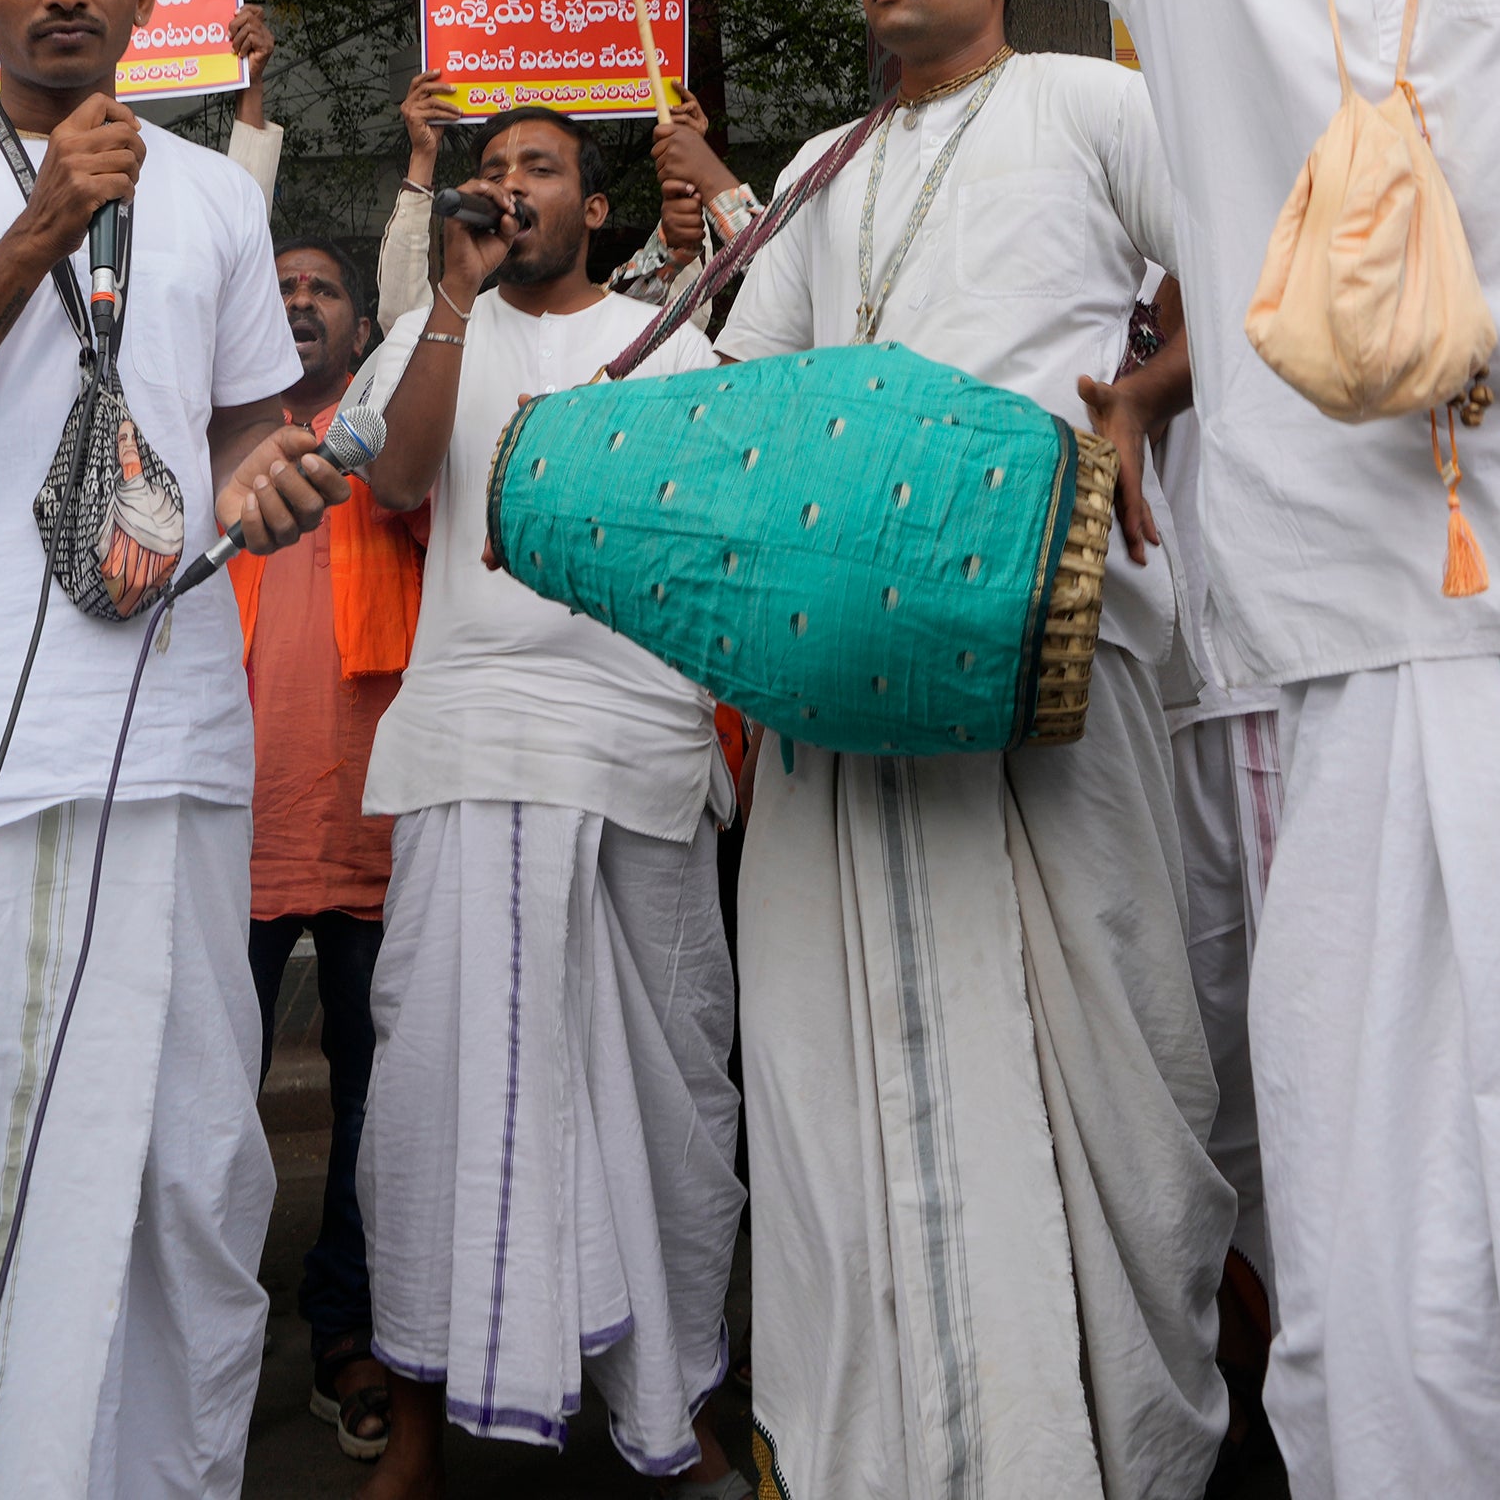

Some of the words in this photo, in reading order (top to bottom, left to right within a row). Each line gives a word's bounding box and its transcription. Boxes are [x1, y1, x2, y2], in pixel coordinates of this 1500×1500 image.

[664, 1, 680, 21] ని
[129, 58, 199, 83] పరిషత్
[446, 45, 515, 72] వెంటనే
[519, 49, 595, 70] విడుదల
[468, 88, 512, 110] విశ్వ
[590, 80, 651, 102] పరిషత్
